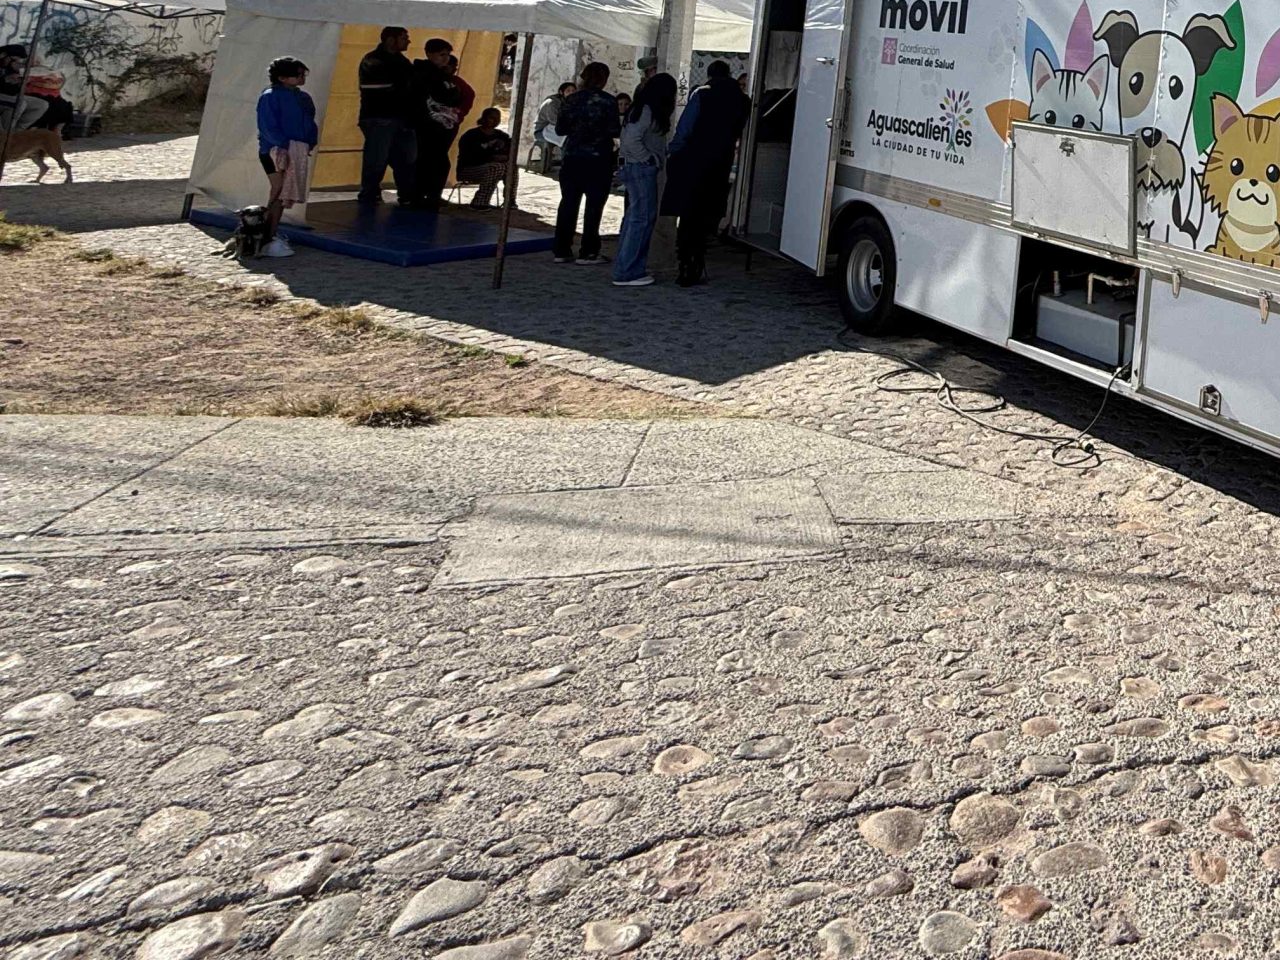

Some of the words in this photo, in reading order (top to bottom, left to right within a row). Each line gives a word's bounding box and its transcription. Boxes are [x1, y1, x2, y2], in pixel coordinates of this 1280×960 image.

[899, 43, 941, 56] Coordinación
[898, 55, 924, 67] General
[925, 57, 934, 68] de
[934, 59, 956, 71] Salud
[872, 137, 881, 147] LA
[884, 139, 914, 155] CIUDAD
[917, 147, 928, 158] DE
[930, 149, 942, 161] TU
[944, 153, 966, 166] VIDA
